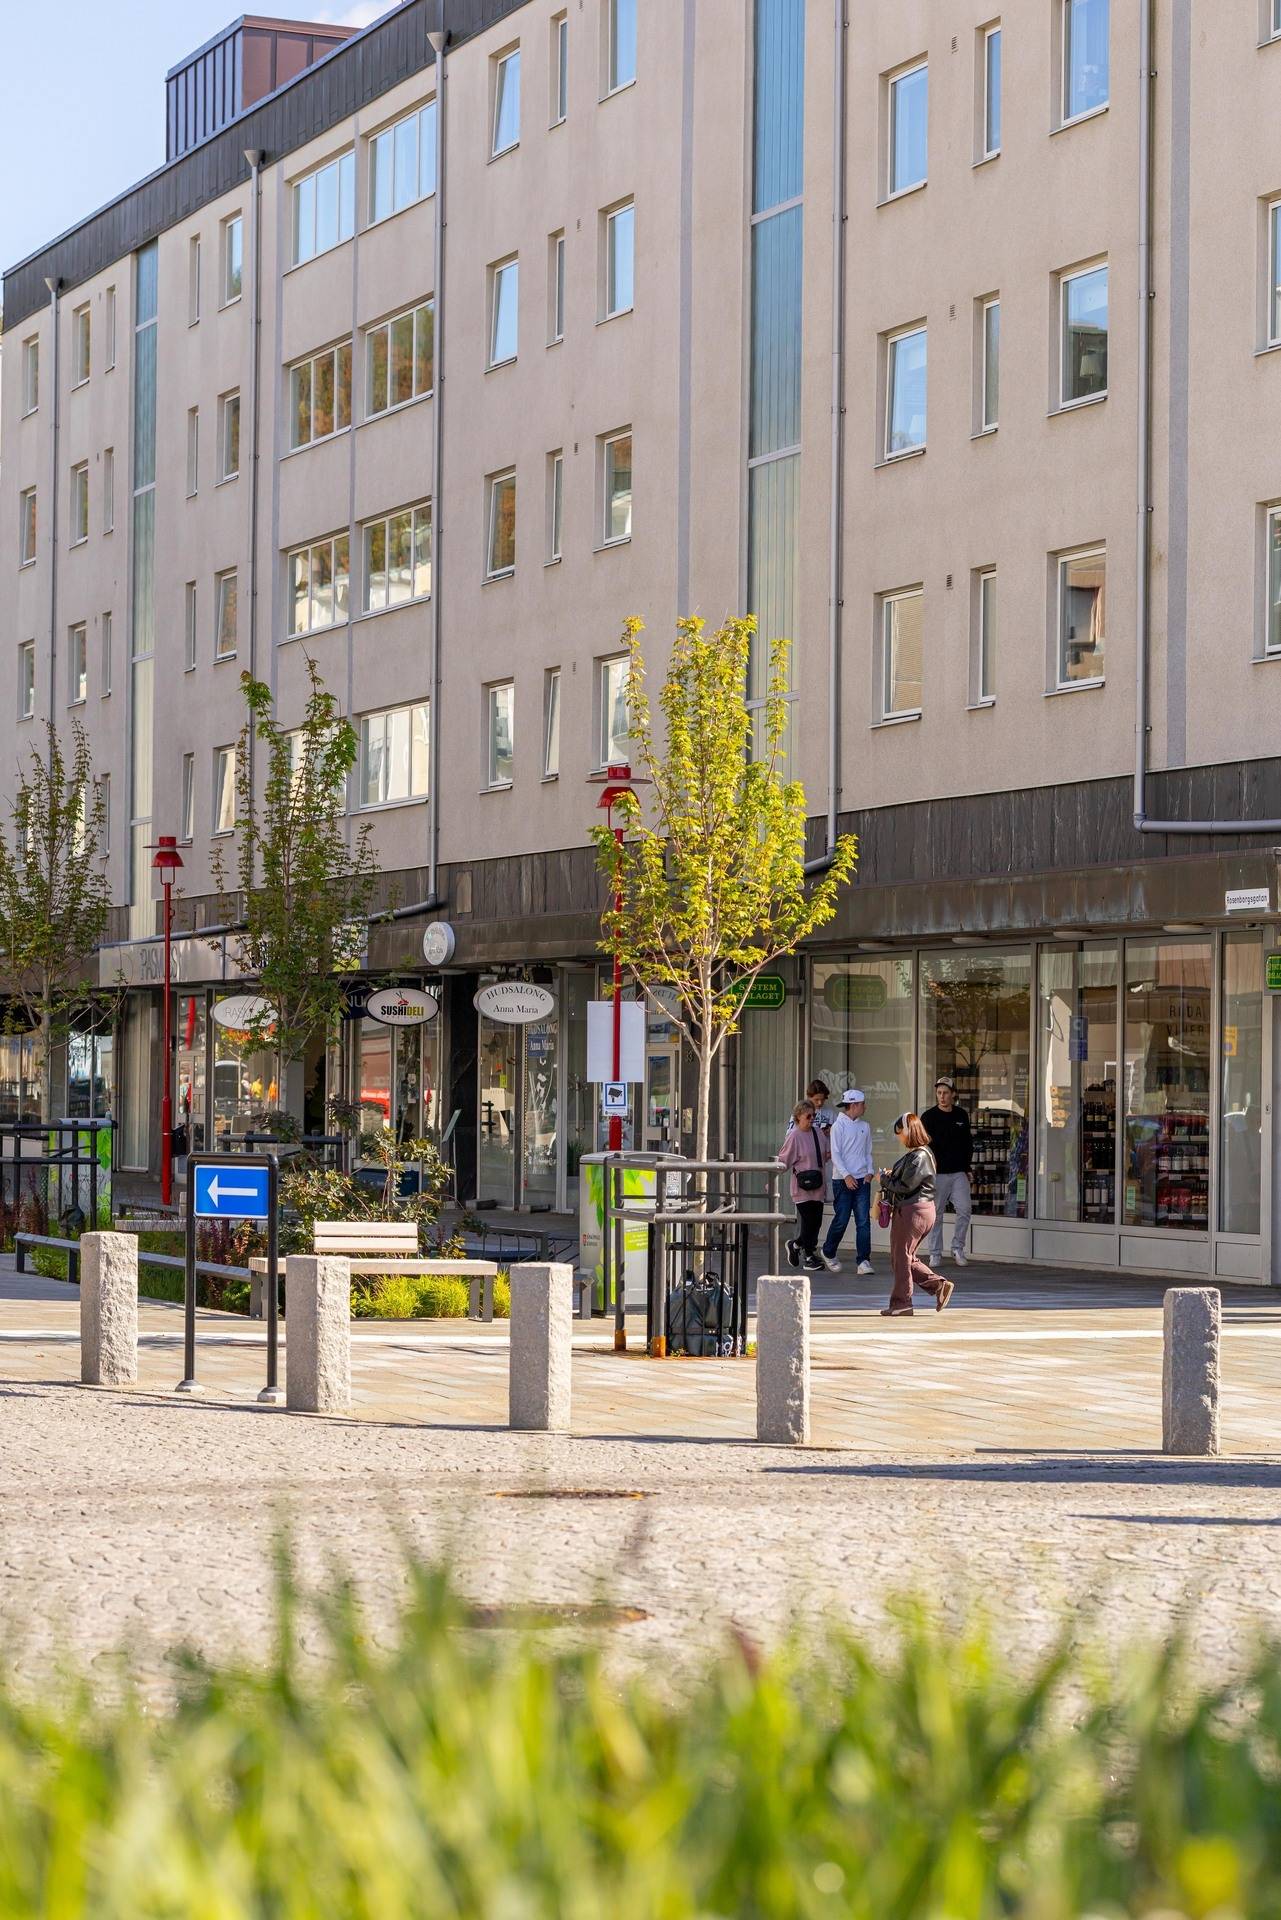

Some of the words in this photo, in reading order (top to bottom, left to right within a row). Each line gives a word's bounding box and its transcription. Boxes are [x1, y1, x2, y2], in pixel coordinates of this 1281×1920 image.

[486, 986, 546, 1001] HUDSALONG
[381, 1005, 424, 1016] SUSHIDELI
[493, 1004, 515, 1013] Anna
[516, 1005, 539, 1014] Maria
